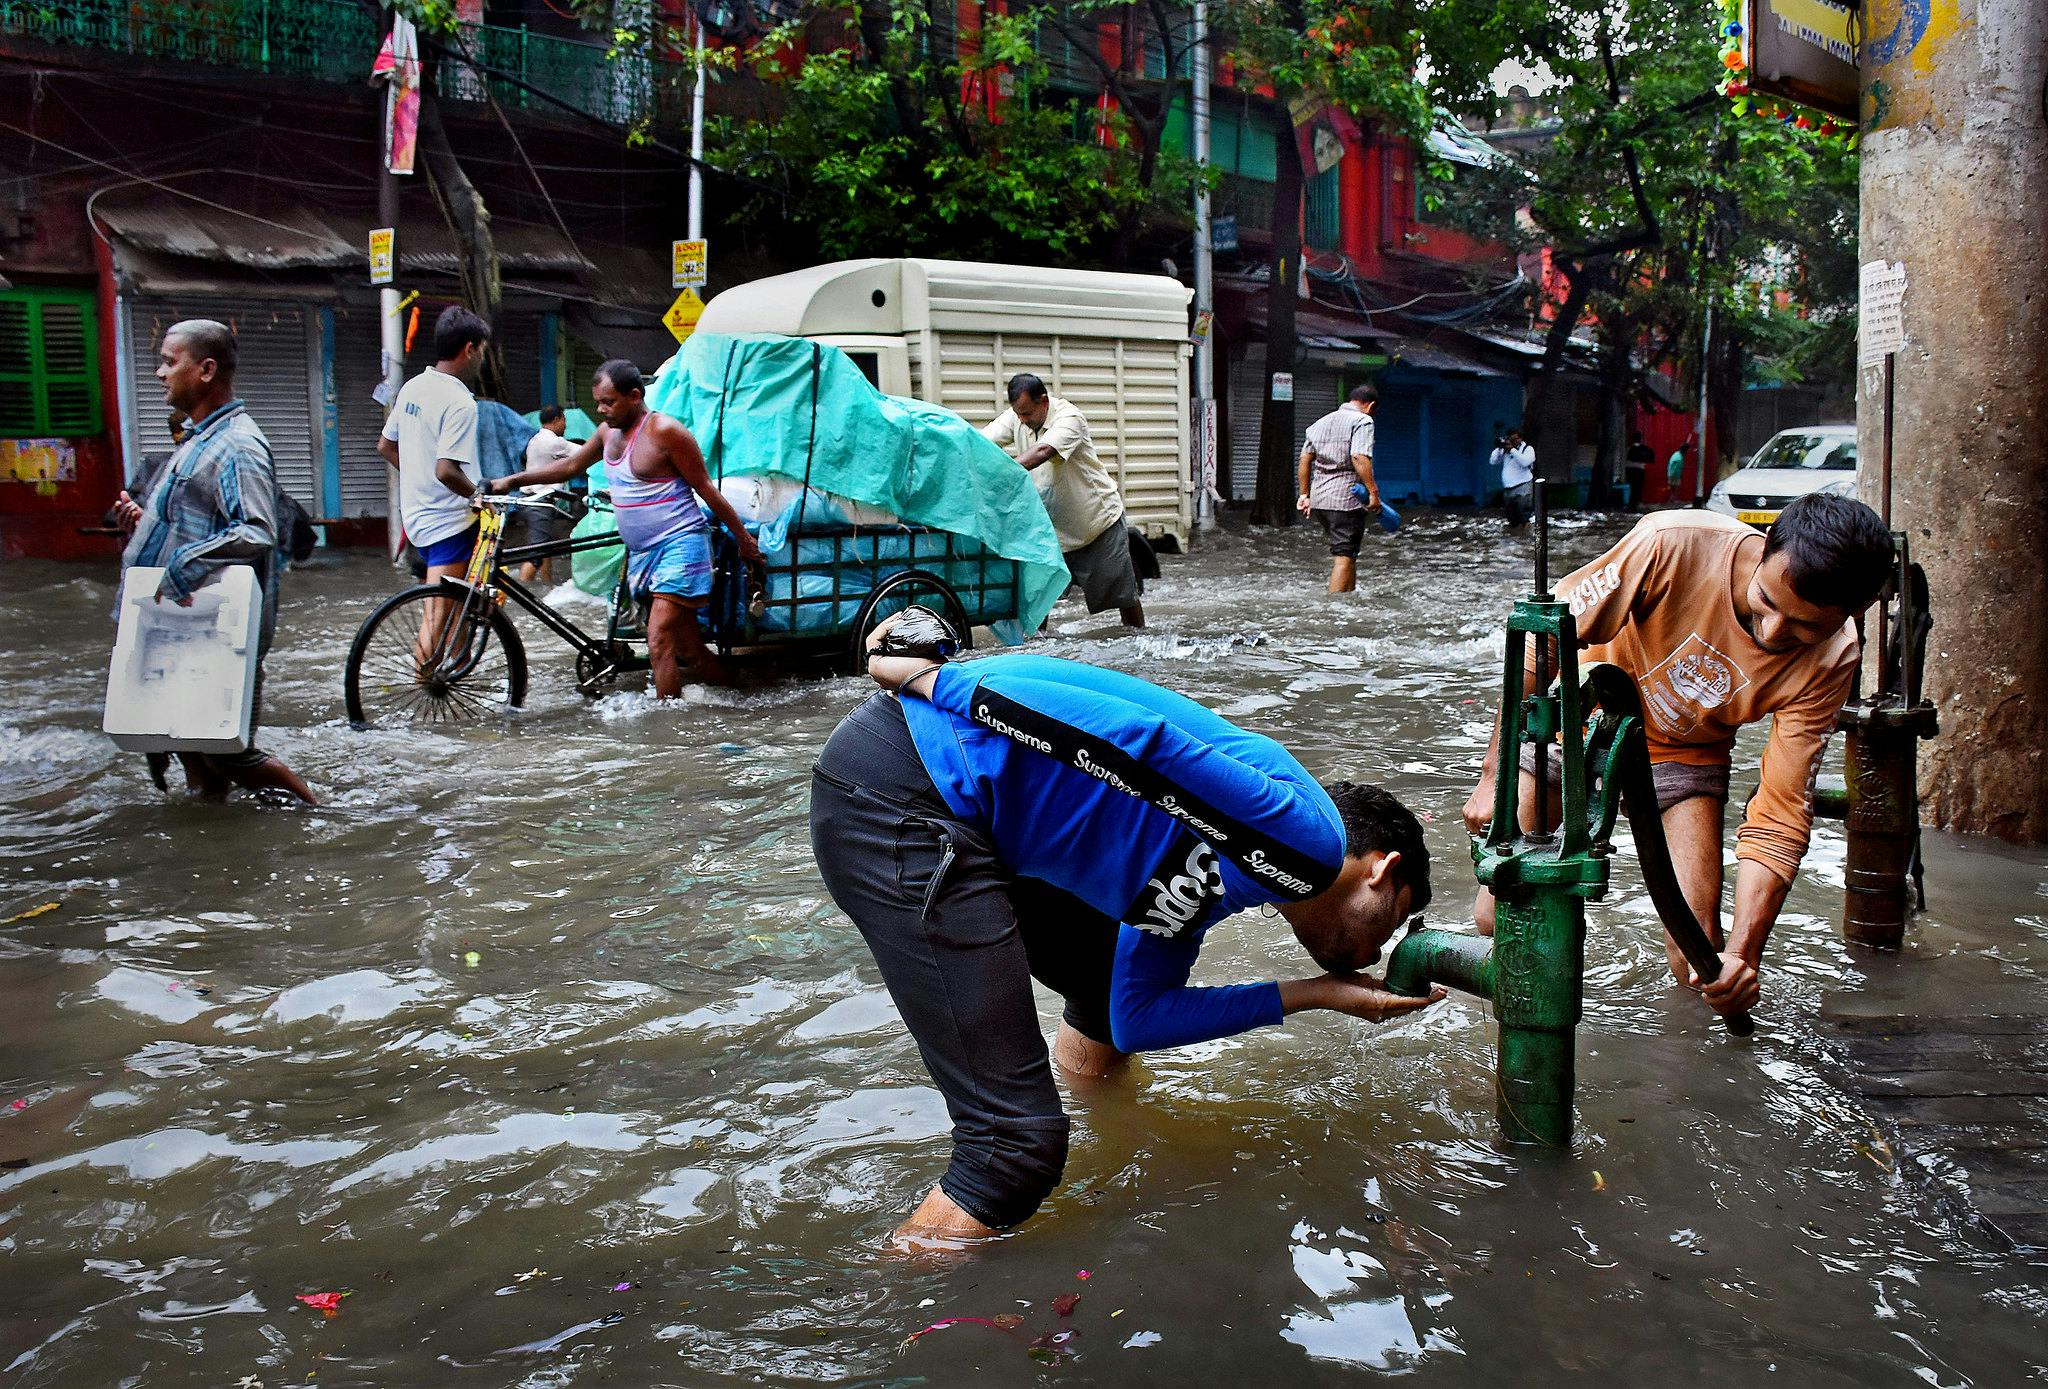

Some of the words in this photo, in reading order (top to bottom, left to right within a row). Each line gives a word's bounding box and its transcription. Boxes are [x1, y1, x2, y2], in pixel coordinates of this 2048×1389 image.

[975, 704, 1052, 753] Supreme
[1074, 748, 1142, 797] Supreme
[1156, 795, 1228, 841] Supreme
[1243, 849, 1313, 894] Supreme
